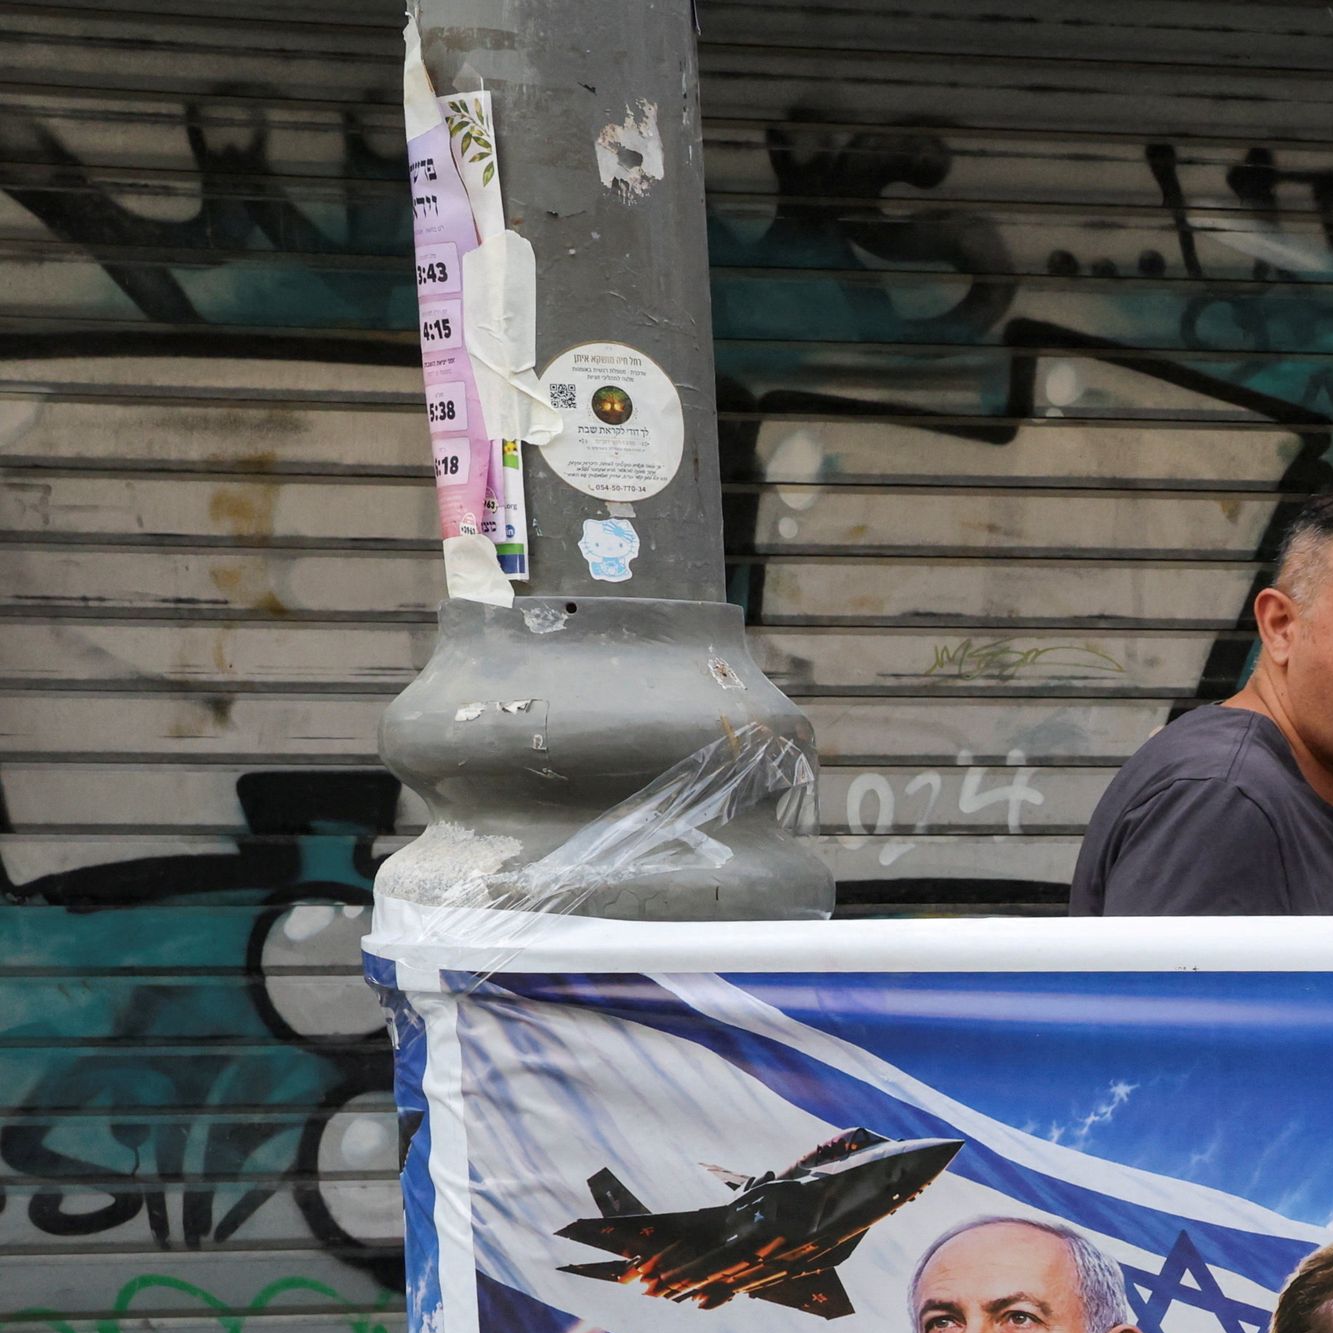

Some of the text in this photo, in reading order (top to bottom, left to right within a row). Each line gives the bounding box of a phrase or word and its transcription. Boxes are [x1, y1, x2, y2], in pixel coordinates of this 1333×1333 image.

[423, 318, 452, 341] 4:15
[429, 400, 456, 423] 5:38
[578, 425, 598, 434] שבת
